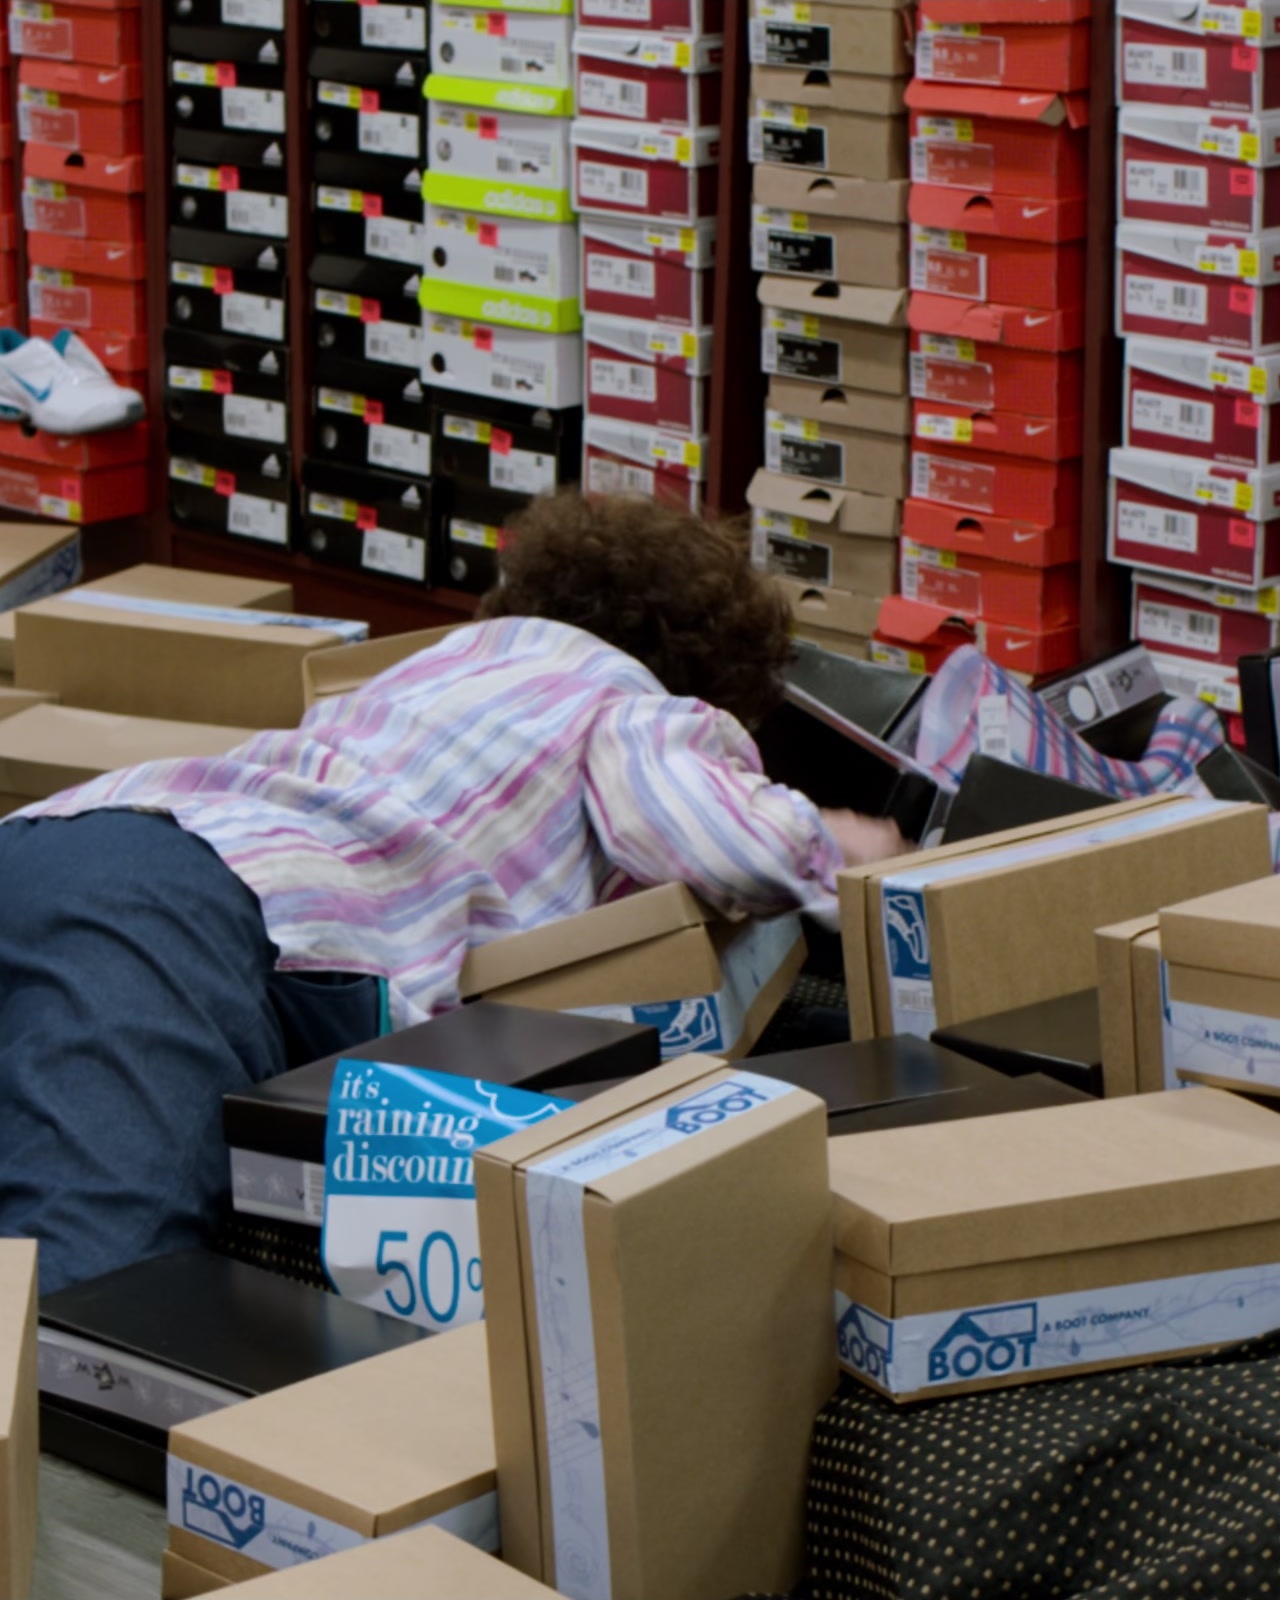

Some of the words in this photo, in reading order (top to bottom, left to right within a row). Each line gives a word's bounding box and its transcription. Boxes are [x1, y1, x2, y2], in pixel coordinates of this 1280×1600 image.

[339, 1068, 380, 1100] it's
[336, 1097, 482, 1150] raining
[669, 1087, 769, 1135] BOOT
[333, 1141, 475, 1186] discoun
[1042, 1322, 1051, 1332] A
[1055, 1316, 1088, 1331] BOOT
[1090, 1308, 1150, 1326] COMPANY
[837, 1332, 892, 1386] BOOT
[928, 1337, 1037, 1382] BOOT
[183, 1467, 265, 1527] BOOT
